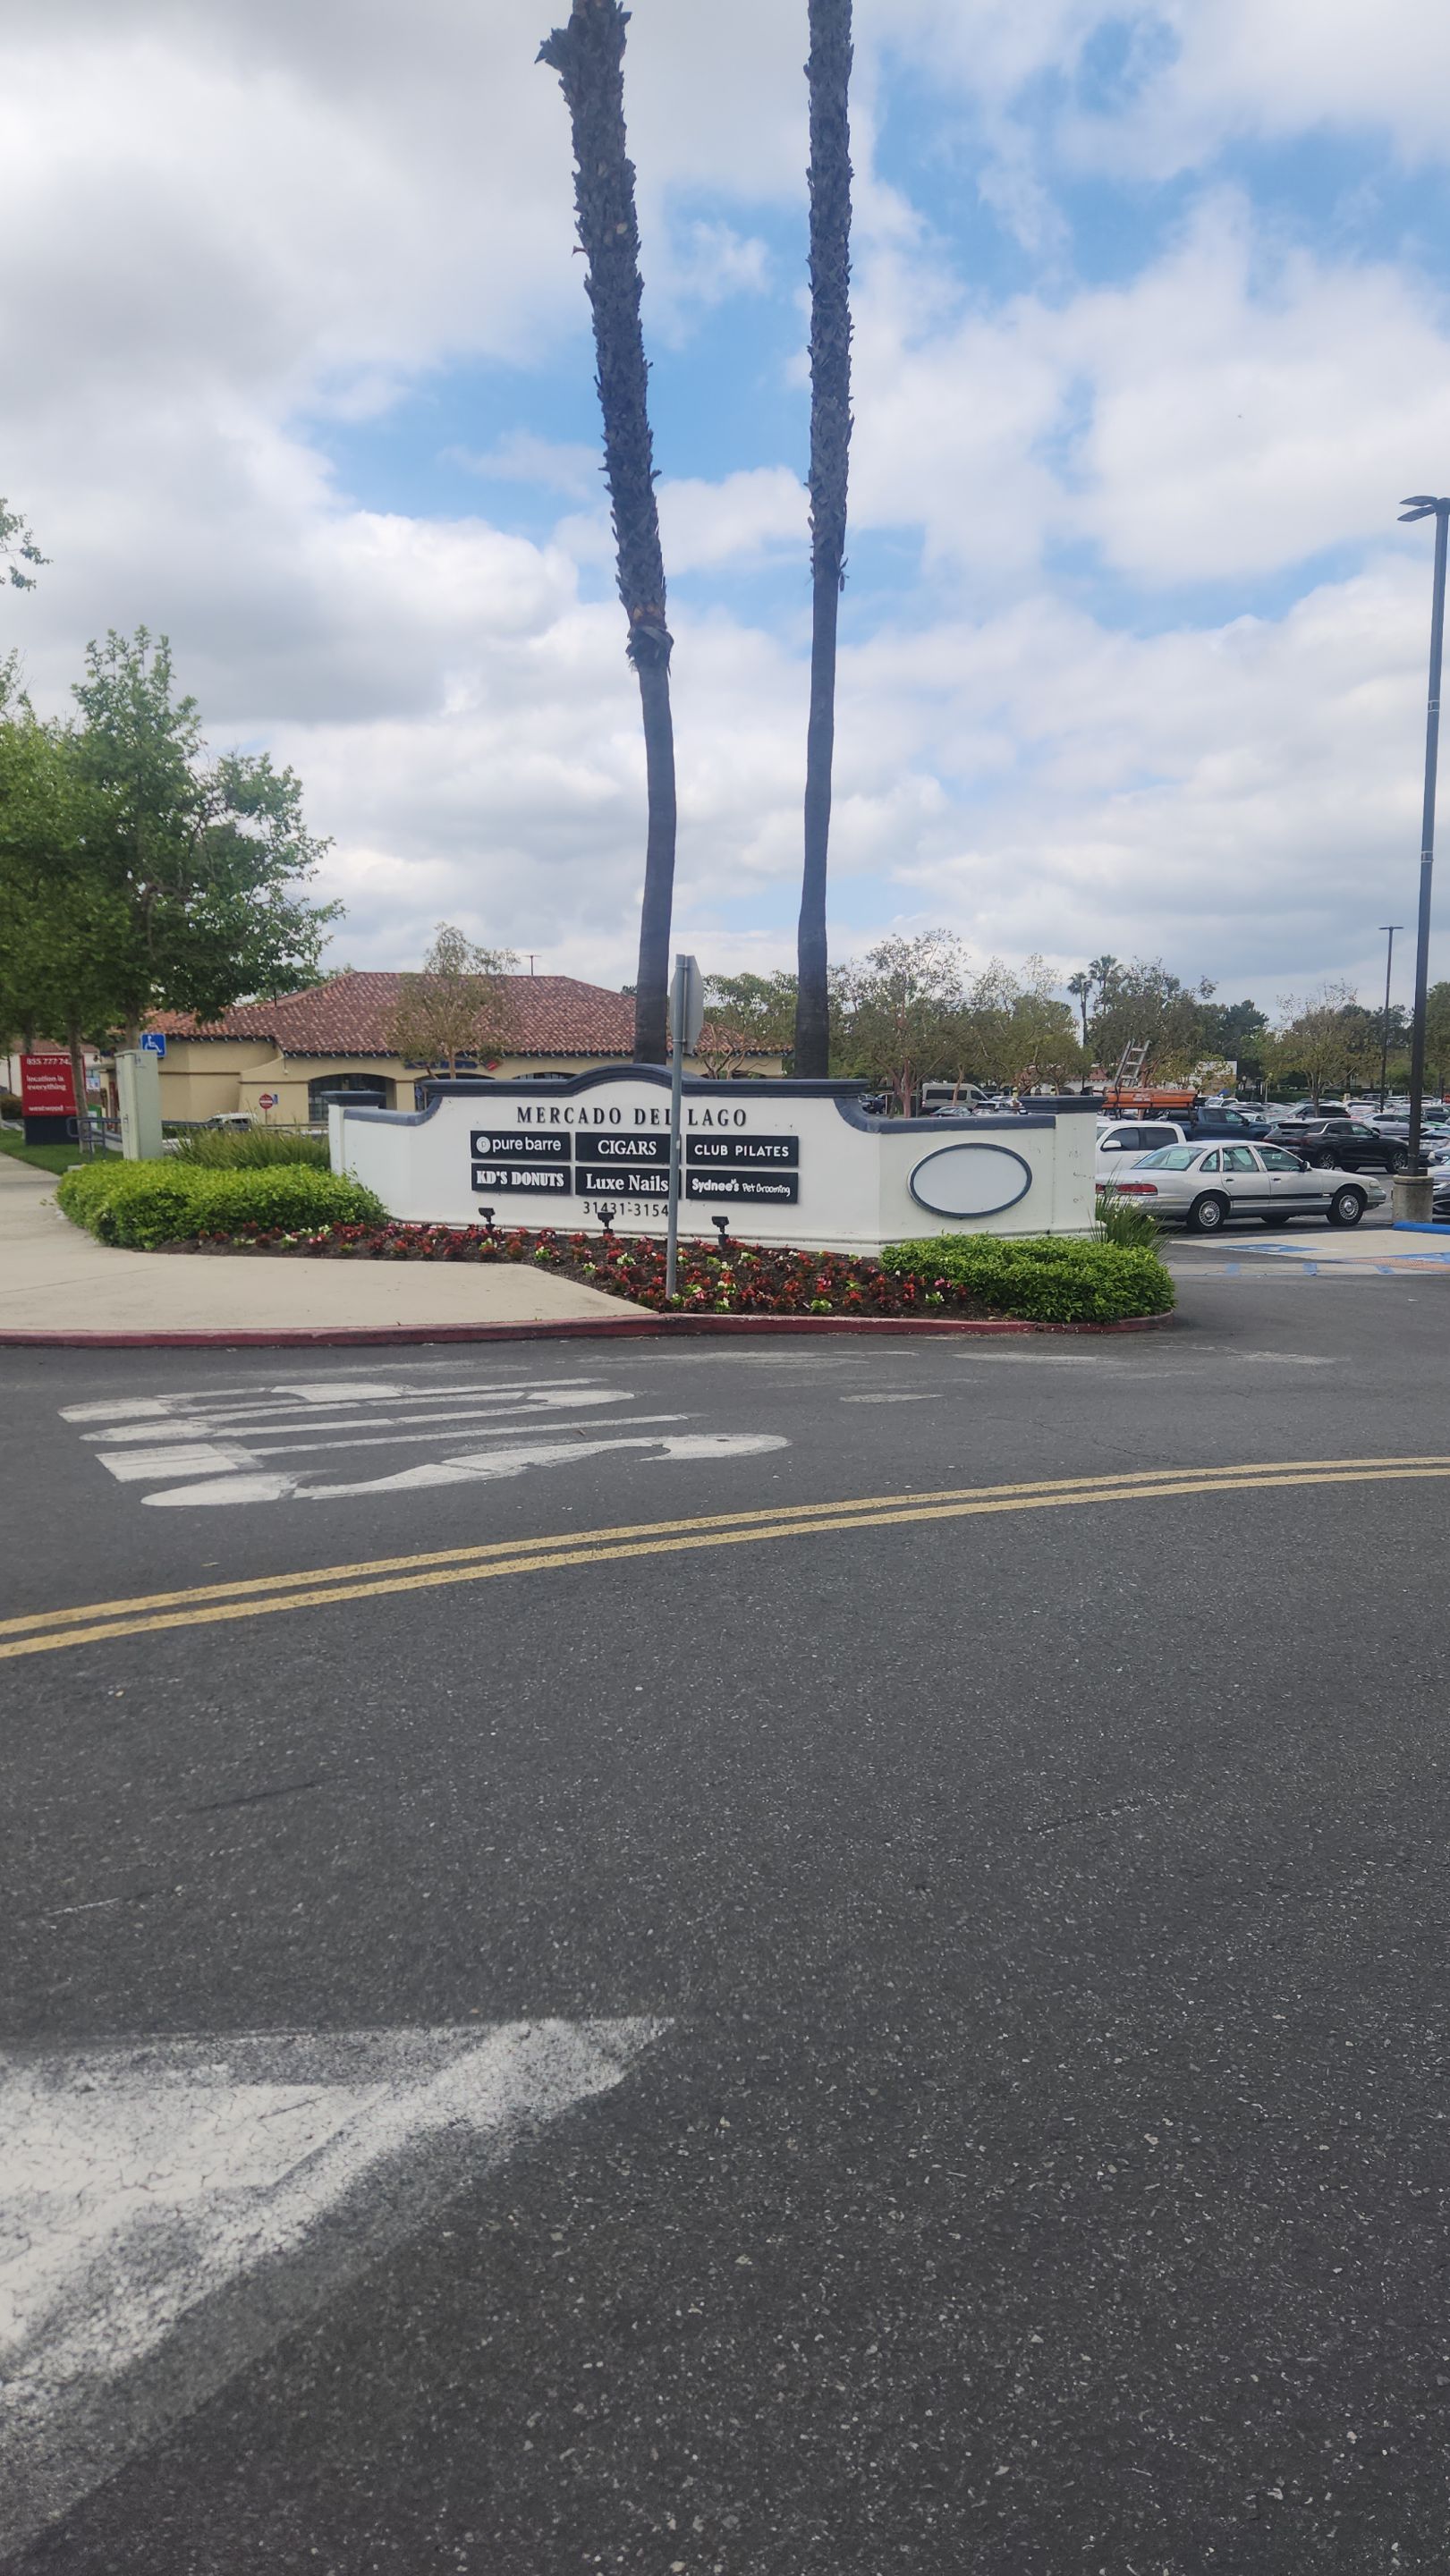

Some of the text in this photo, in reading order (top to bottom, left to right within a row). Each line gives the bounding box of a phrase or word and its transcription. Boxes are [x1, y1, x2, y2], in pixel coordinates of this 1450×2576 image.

[517, 1106, 622, 1124] MERCADO
[687, 1108, 747, 1126] LAGO
[492, 1138, 523, 1153] pure
[525, 1137, 561, 1151] barre
[598, 1140, 657, 1155] CIGARS
[694, 1144, 789, 1157] CLUB PILATES
[476, 1170, 564, 1187] KD'S DONUTS
[586, 1174, 669, 1192] Luxe Nails
[742, 1182, 756, 1193] Pet
[756, 1183, 791, 1197] Grooming
